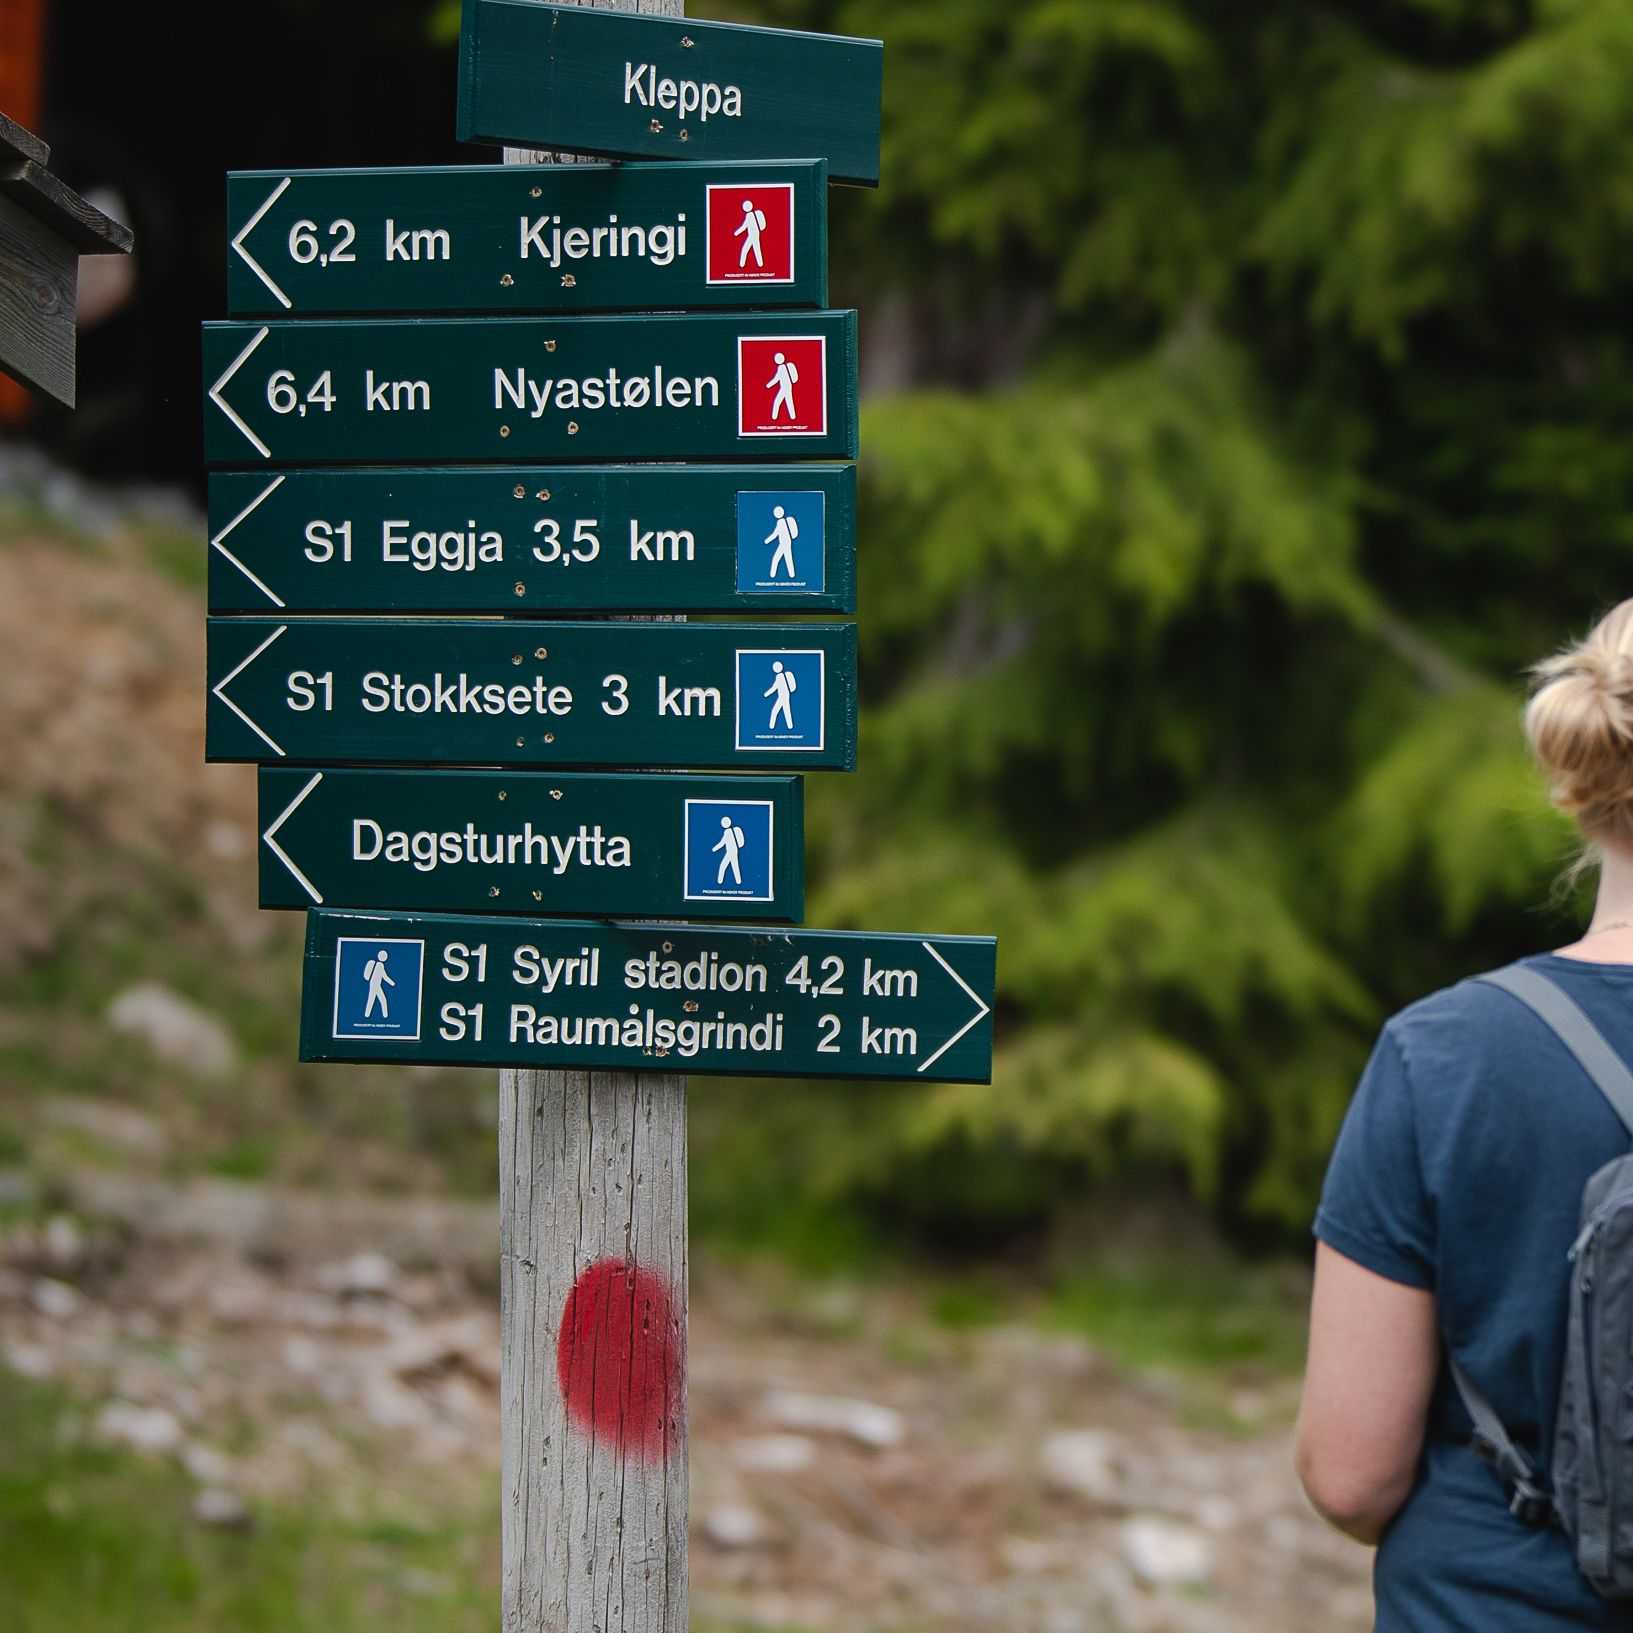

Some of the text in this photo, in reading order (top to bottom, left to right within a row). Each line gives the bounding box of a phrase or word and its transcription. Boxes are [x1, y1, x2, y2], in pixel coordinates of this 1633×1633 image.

[624, 61, 743, 122] Kleppa
[288, 213, 687, 268] 6,2 km Kjeringi
[267, 364, 719, 419] 6,4 km Nyastølen
[303, 518, 696, 572] S1 Eggja 3,5 km
[286, 670, 722, 717] S1 Stokksete 3 km
[352, 818, 632, 875] Dagsturhytta
[442, 941, 919, 1002] S1 Syril stadion 4,2 km
[438, 1001, 918, 1058] S1 Raumålsgrindi 2 km
